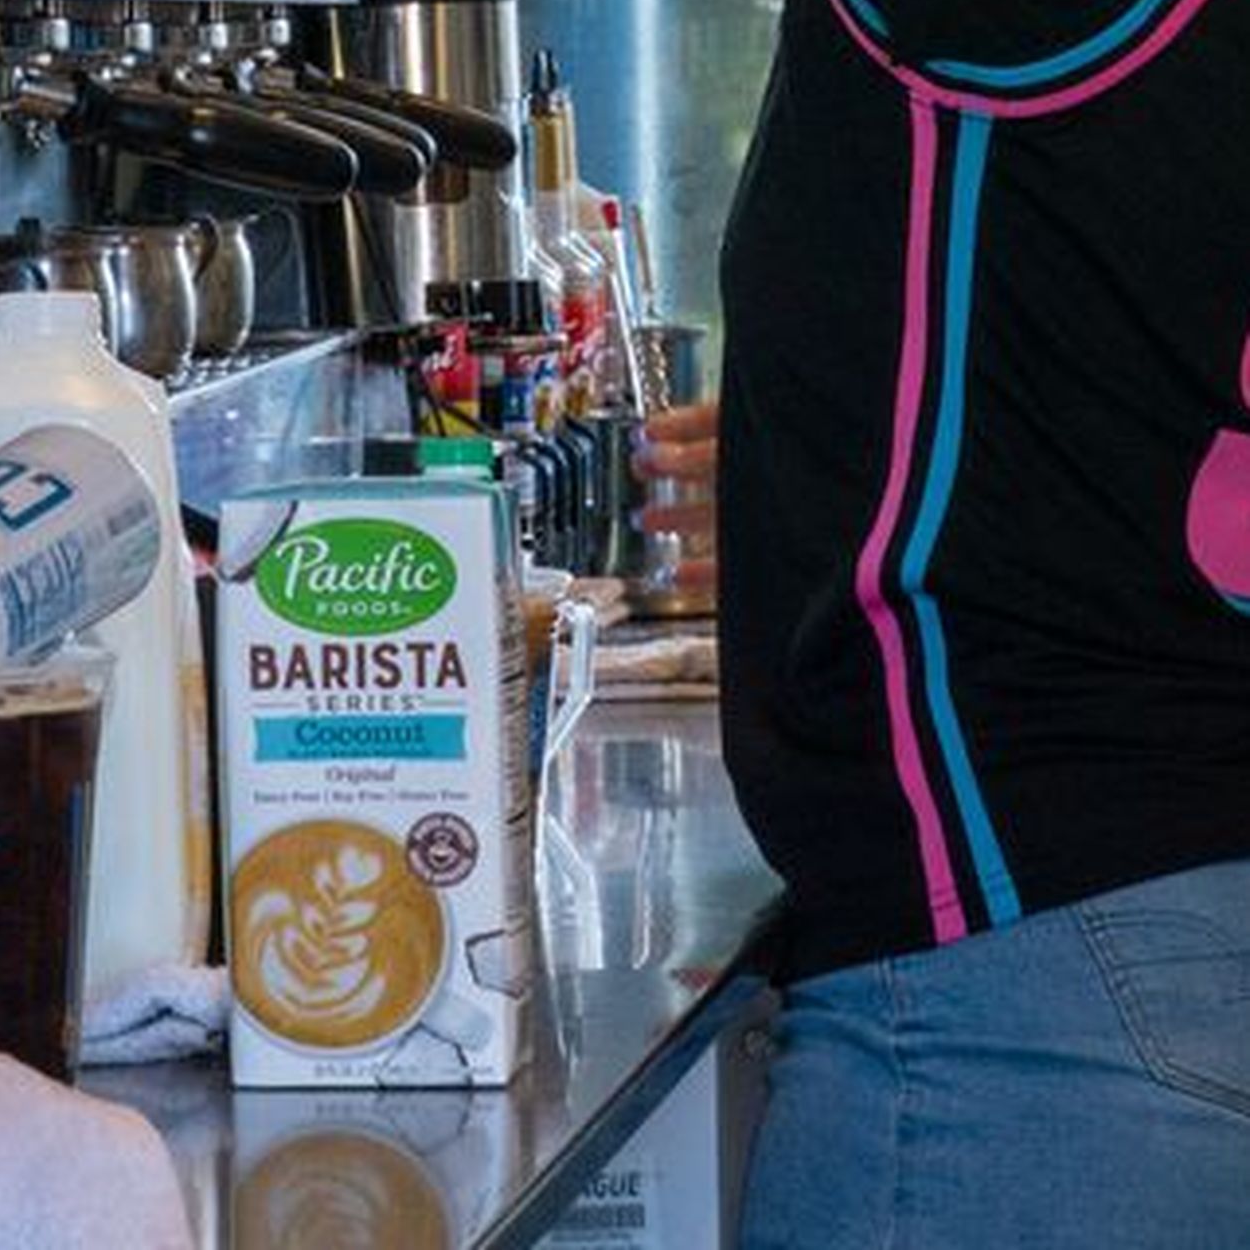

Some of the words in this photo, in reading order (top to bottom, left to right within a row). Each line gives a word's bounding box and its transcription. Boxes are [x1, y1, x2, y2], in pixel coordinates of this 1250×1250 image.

[275, 534, 442, 600] Pacific
[250, 643, 468, 691] BARISTA
[306, 694, 418, 712] SERIES
[295, 719, 426, 746] Coconut
